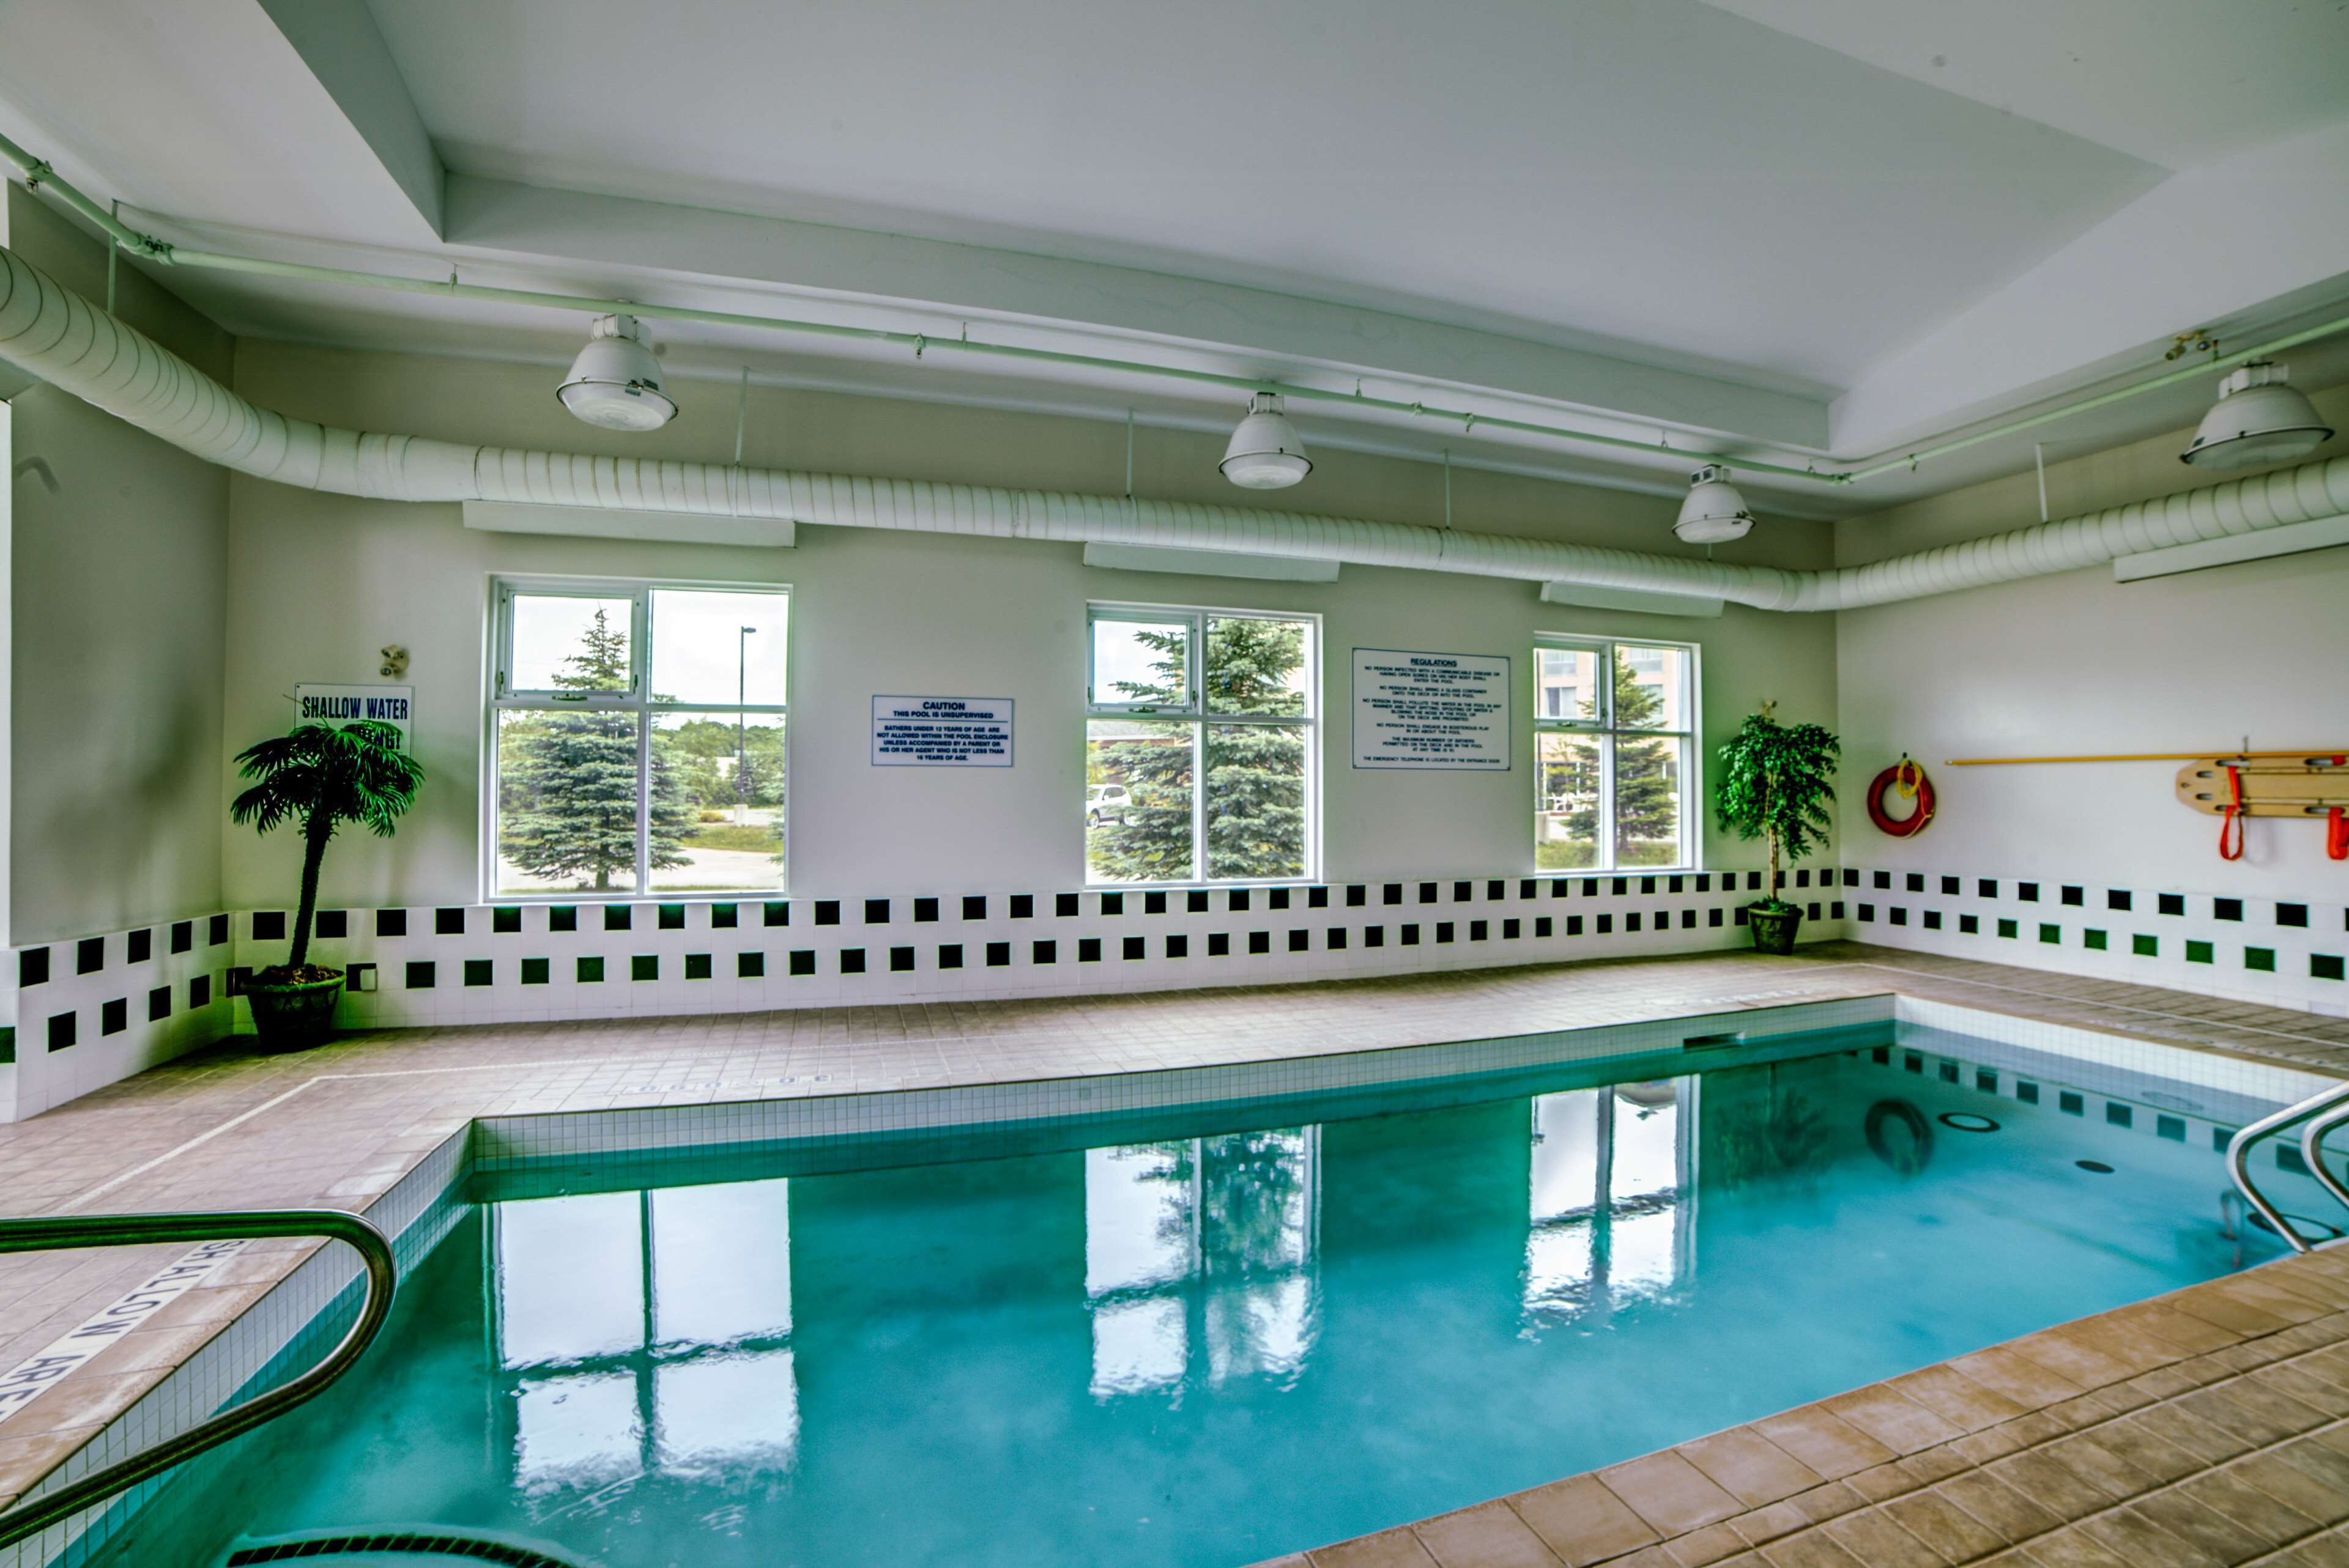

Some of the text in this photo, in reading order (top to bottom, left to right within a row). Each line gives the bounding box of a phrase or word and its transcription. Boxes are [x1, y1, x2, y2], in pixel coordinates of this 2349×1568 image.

[302, 697, 408, 719] SHALLOW WATER
[922, 701, 965, 711] CAUTION
[70, 1240, 245, 1338] SHALLOW
